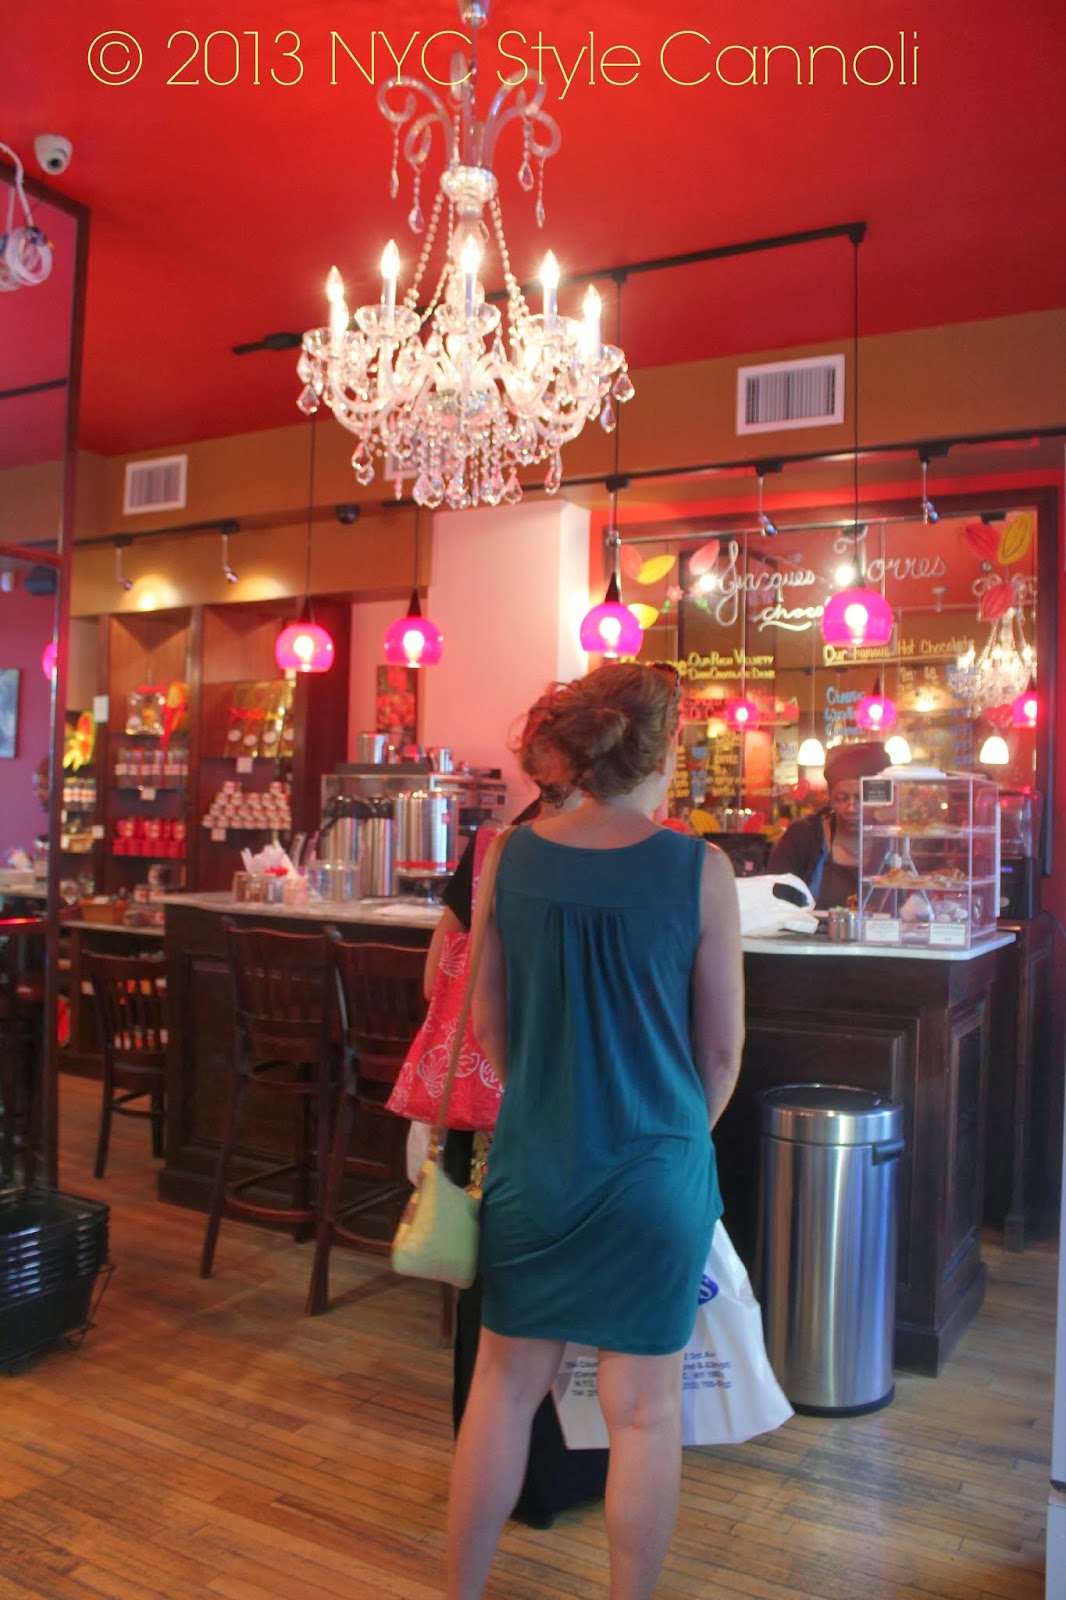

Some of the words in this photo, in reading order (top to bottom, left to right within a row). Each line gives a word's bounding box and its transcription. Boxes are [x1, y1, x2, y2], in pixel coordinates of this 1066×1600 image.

[715, 540, 816, 627] Jacques
[823, 644, 849, 663] Our
[897, 639, 915, 656] Hot
[920, 635, 975, 655] Chocolate
